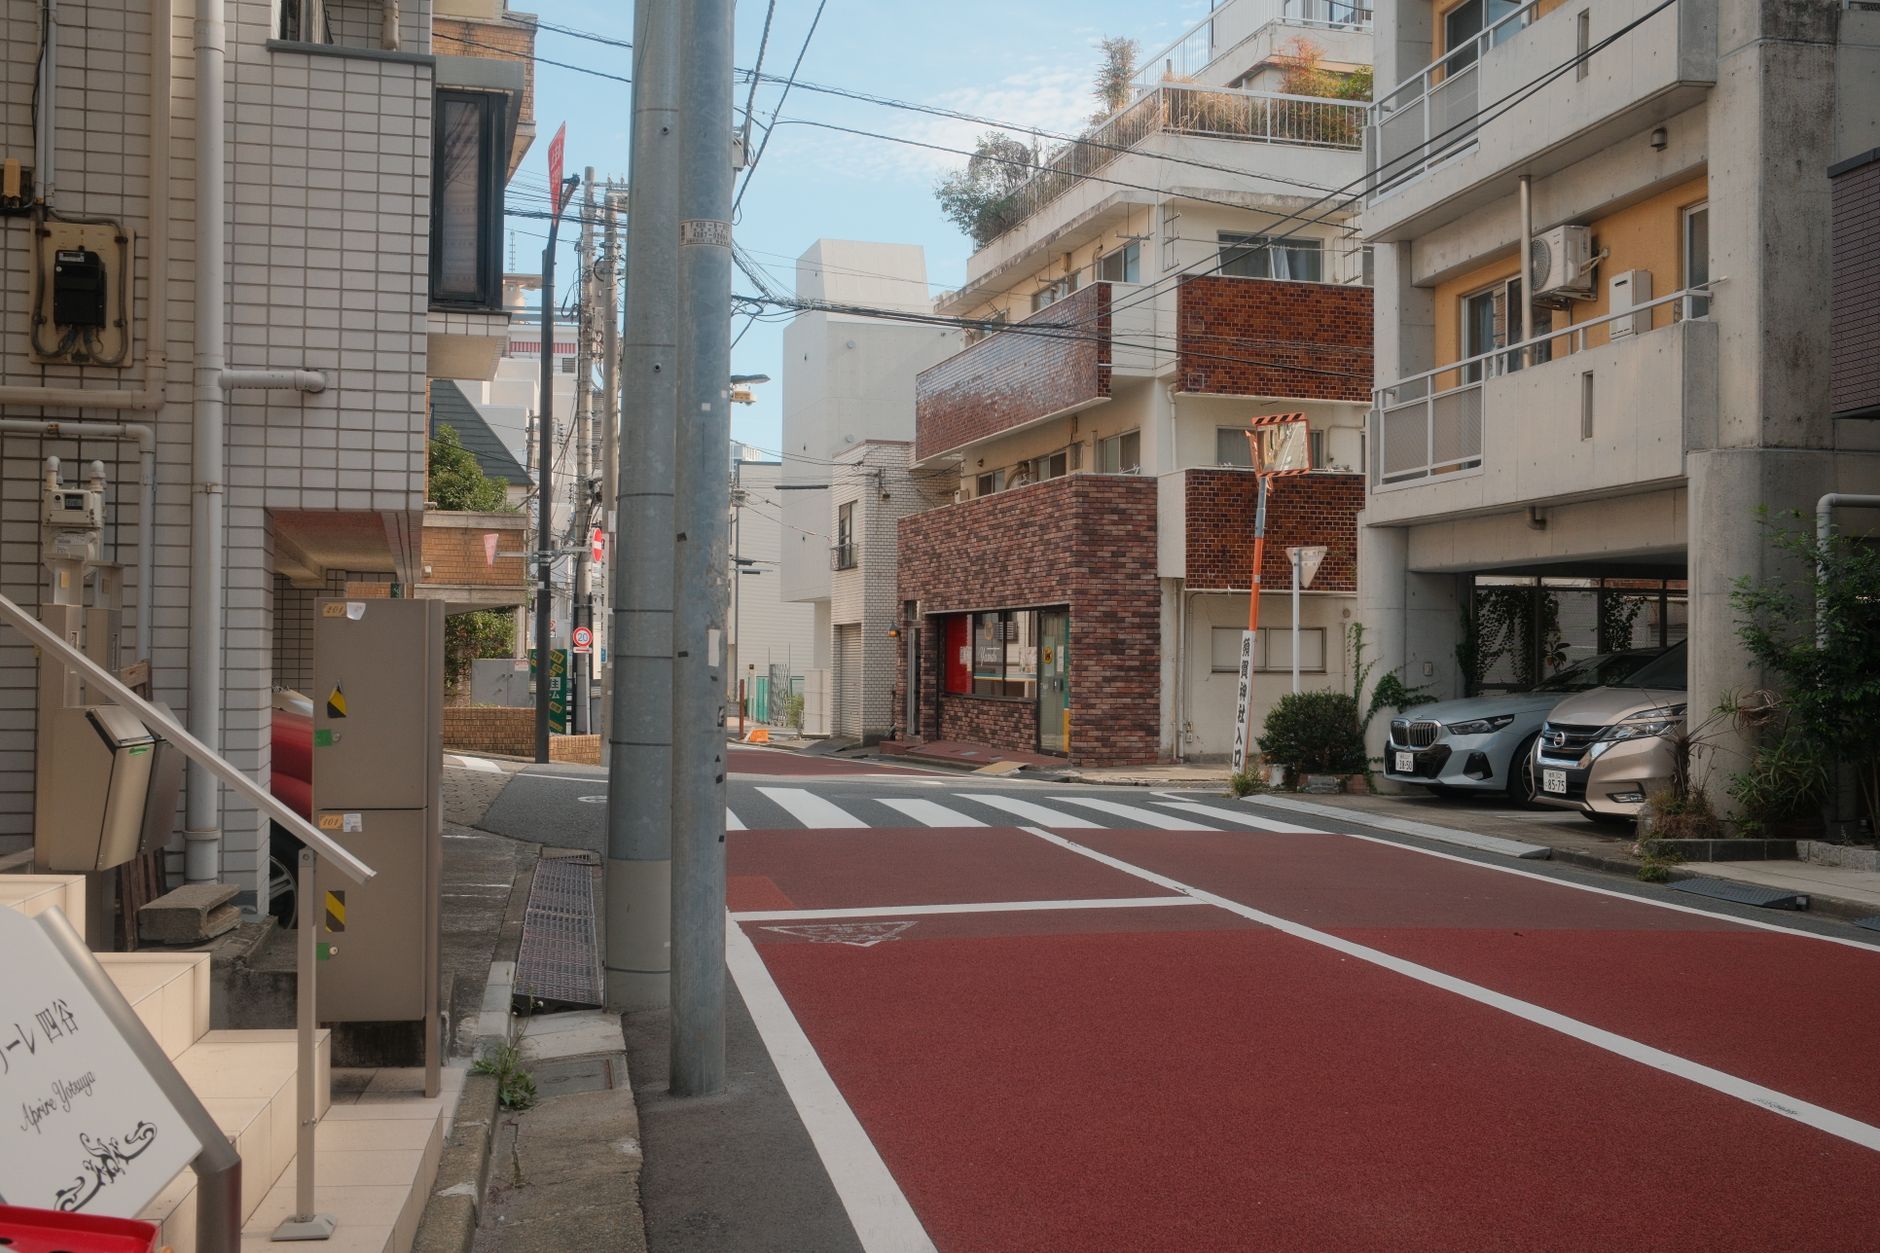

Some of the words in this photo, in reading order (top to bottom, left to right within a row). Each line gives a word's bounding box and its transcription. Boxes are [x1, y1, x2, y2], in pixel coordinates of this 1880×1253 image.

[577, 633, 588, 642] 20
[35, 998, 79, 1044] 四谷
[20, 1097, 57, 1135] Aprire
[51, 1071, 96, 1113] Yotsuya
